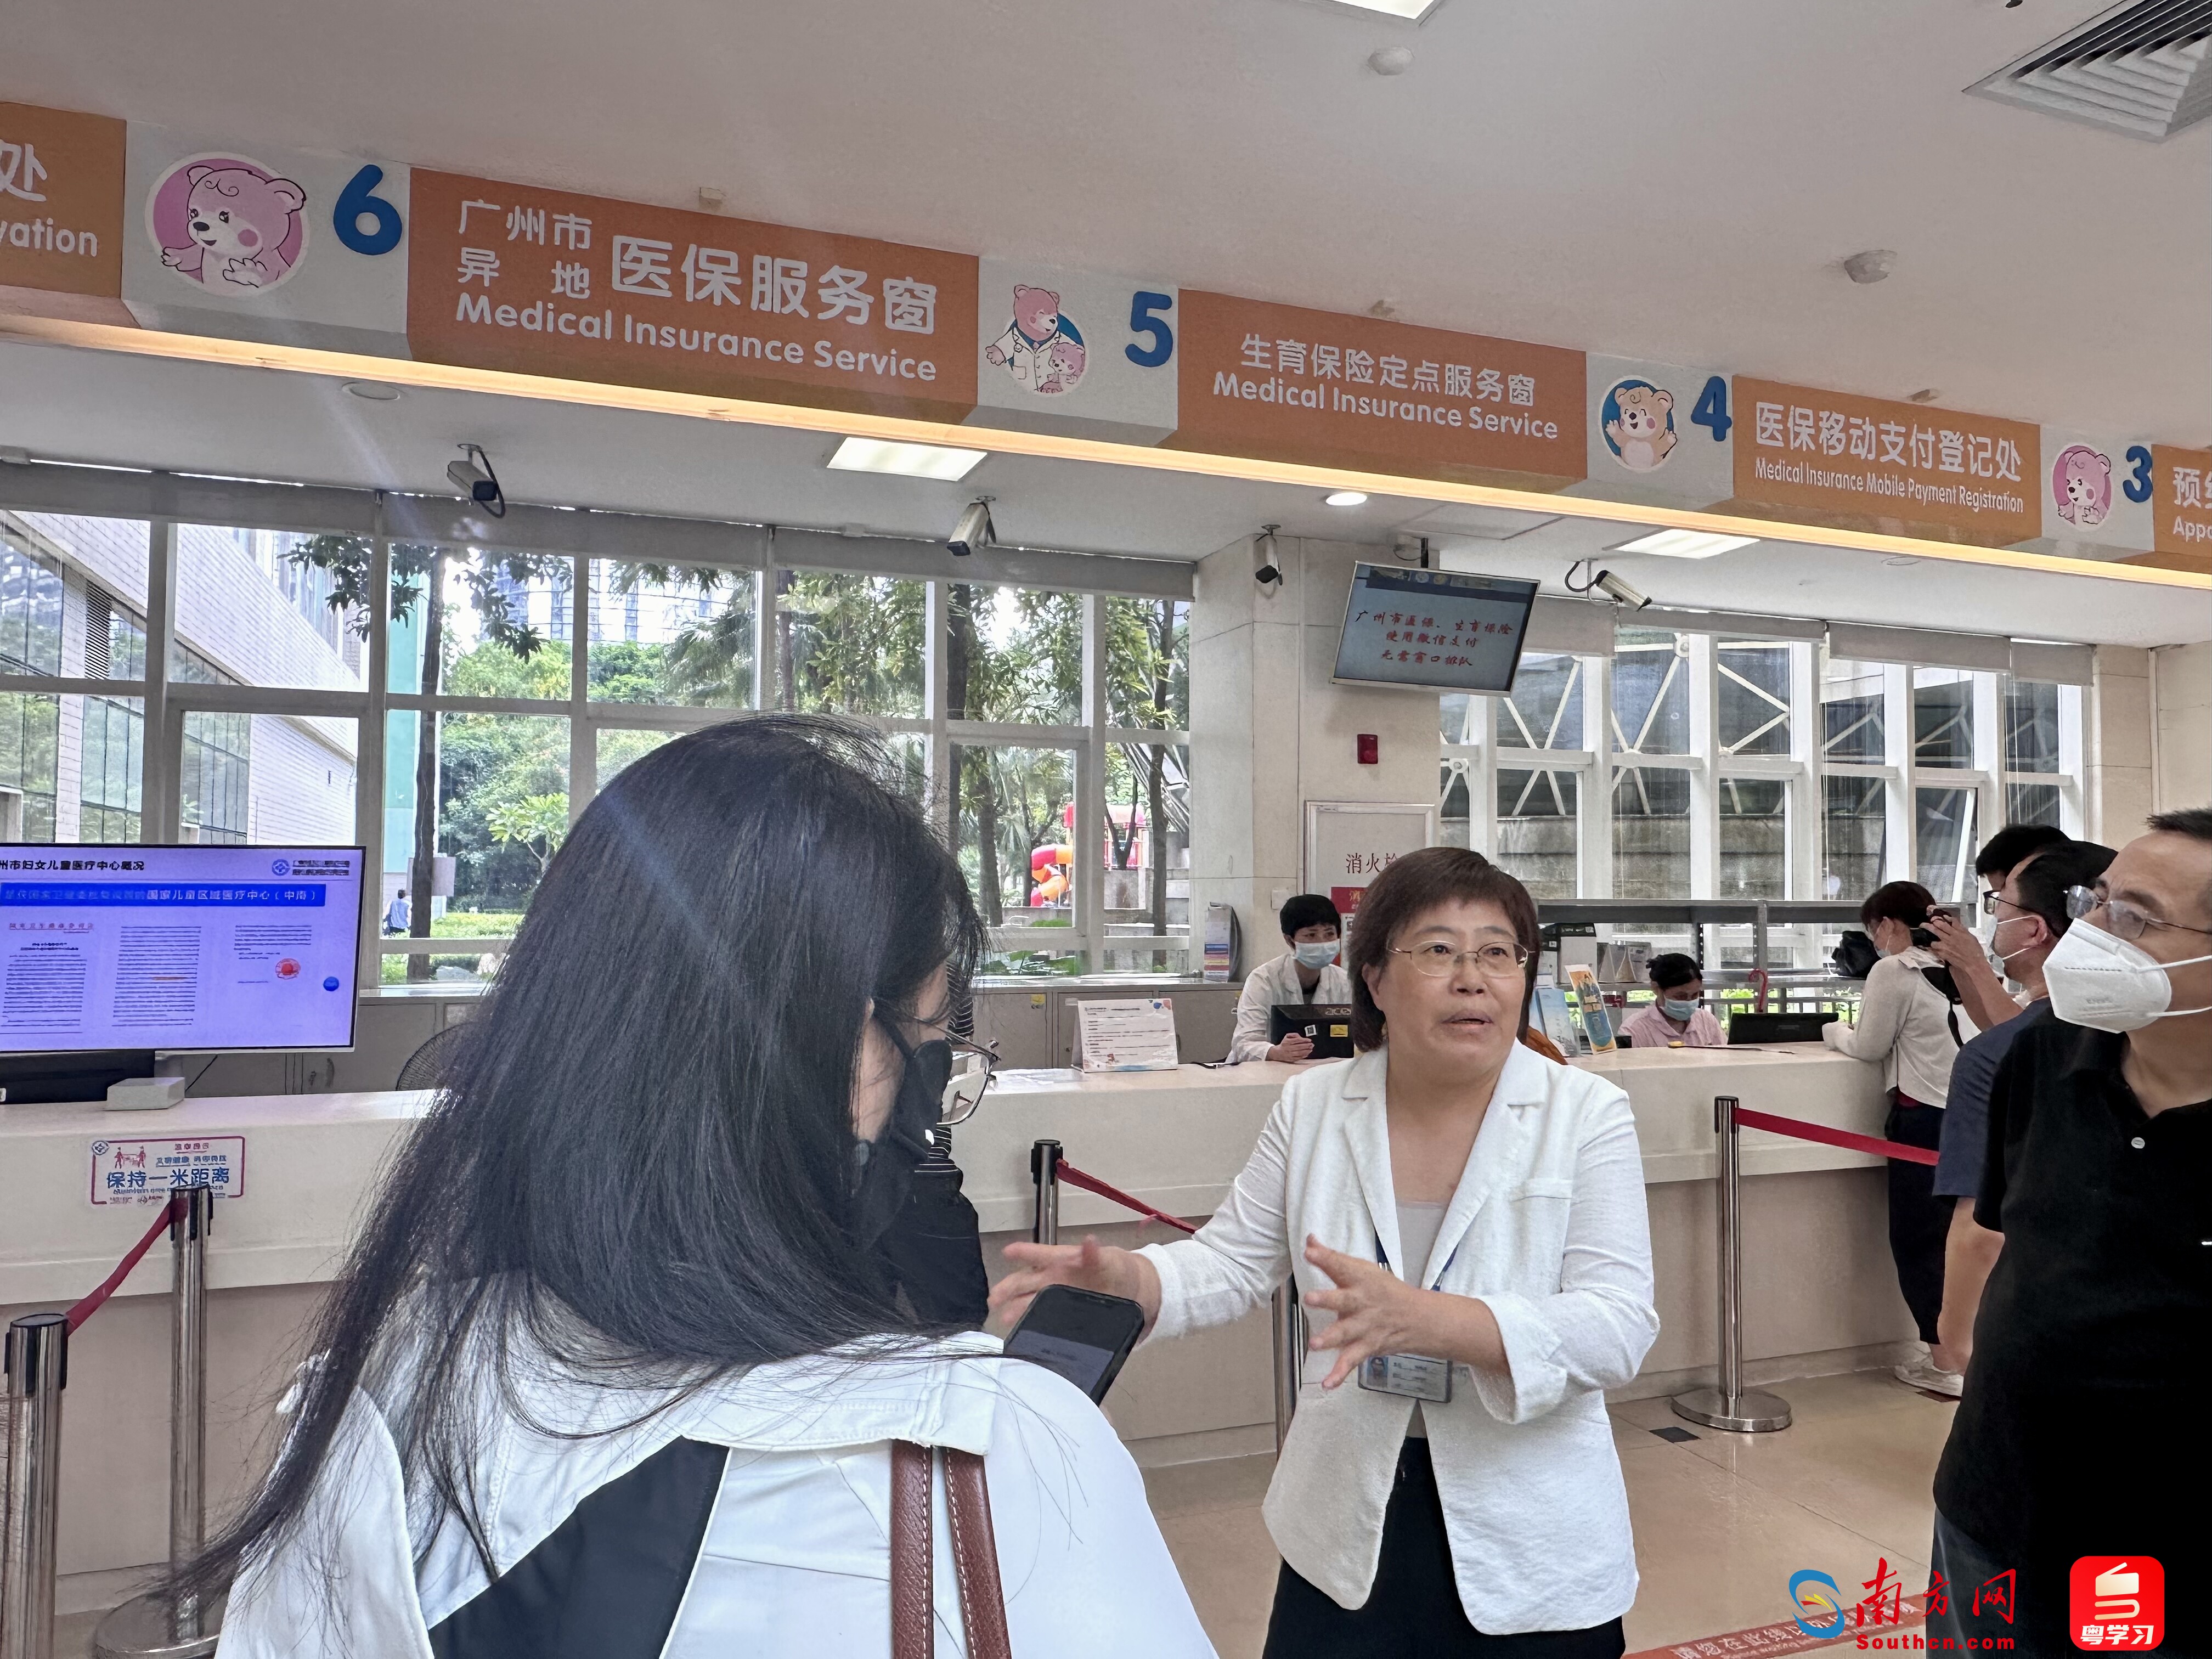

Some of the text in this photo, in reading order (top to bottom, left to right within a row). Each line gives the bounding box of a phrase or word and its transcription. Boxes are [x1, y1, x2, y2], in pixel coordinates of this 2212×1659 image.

[0, 139, 48, 202] 处
[333, 164, 402, 255] 6
[458, 199, 592, 250] 广州市
[611, 234, 937, 335] 医保服务窗
[456, 292, 937, 381] Medical Insurance Service
[1125, 291, 1173, 368] 5
[1213, 370, 1558, 439] Medical Insurance Service
[1240, 333, 1536, 407] 生育保险定点服务窗
[1690, 376, 1732, 442] 4
[1756, 401, 2022, 482] 医保移动支付登记处
[1756, 457, 2023, 513] Medical Insurance Mobile Payment Registration
[2123, 445, 2153, 503] 3
[107, 1167, 230, 1188] 保持一米距离
